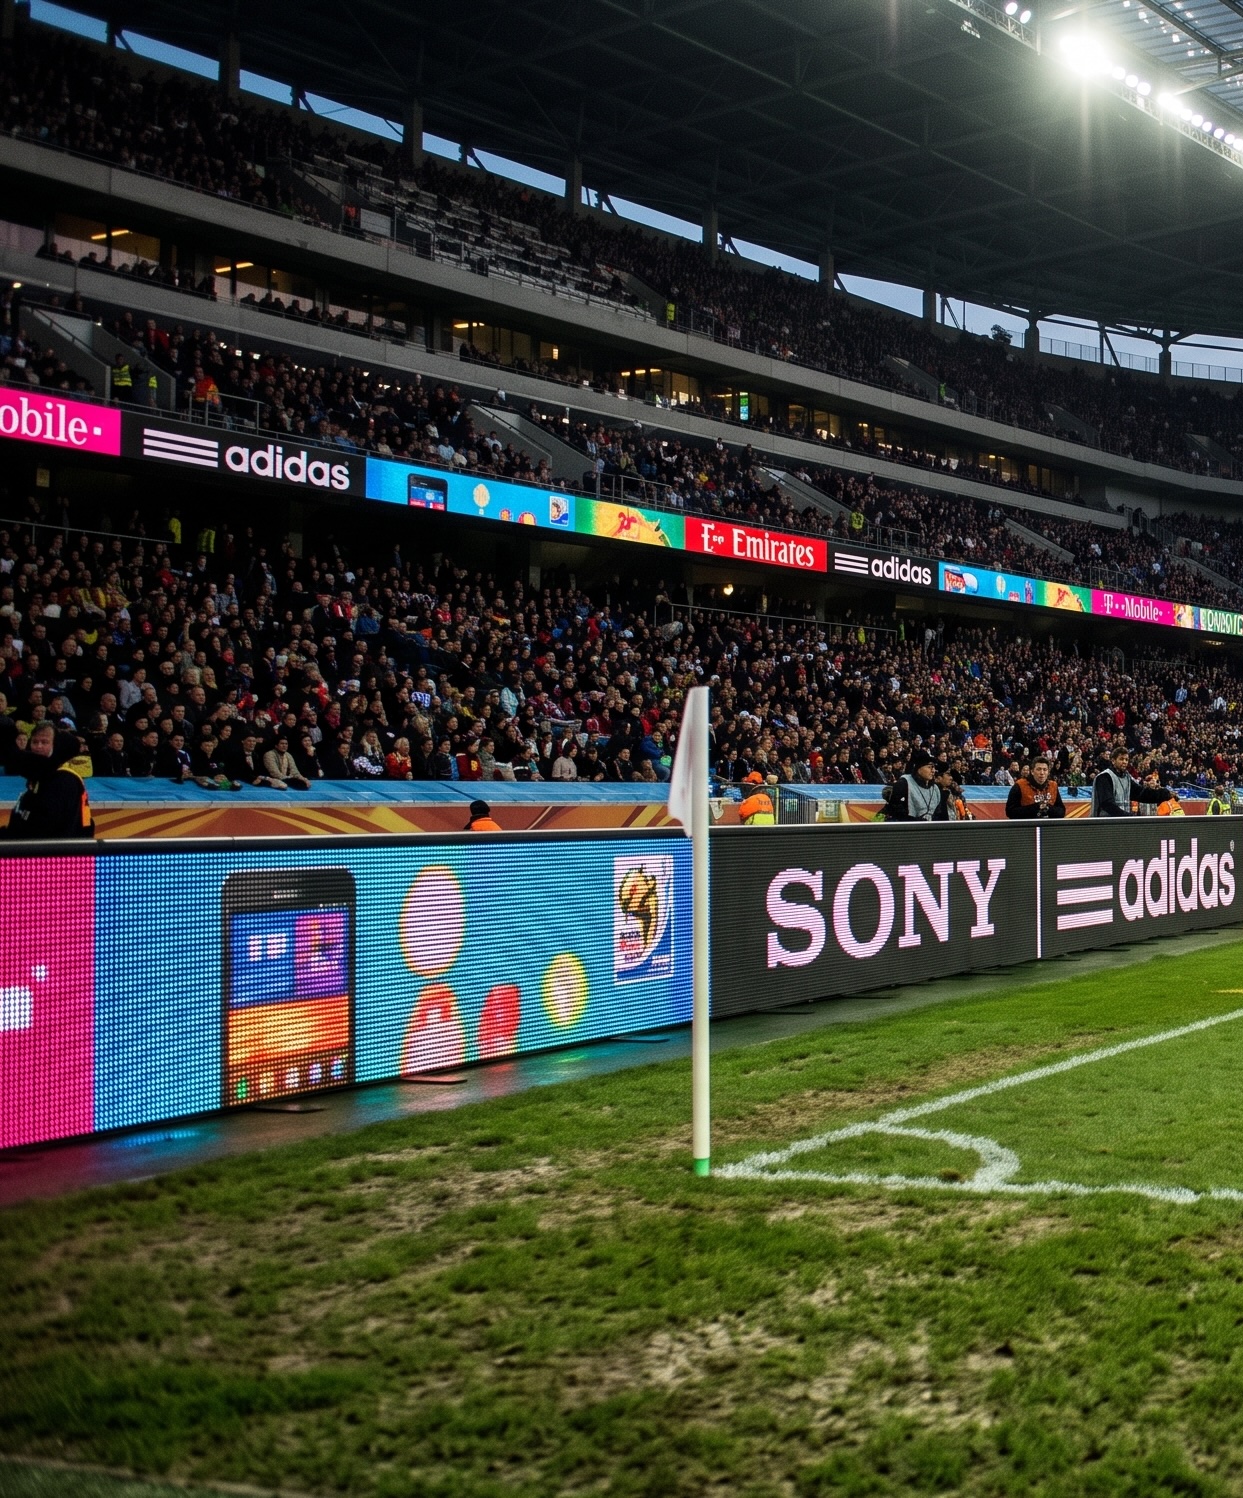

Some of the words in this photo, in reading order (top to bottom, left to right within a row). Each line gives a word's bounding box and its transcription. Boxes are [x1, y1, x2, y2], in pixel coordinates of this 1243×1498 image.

[225, 444, 350, 490] adidas
[732, 528, 815, 567] Emirates
[871, 556, 932, 586] adidas
[1118, 838, 1236, 922] adidas
[766, 858, 1007, 968] SONY
